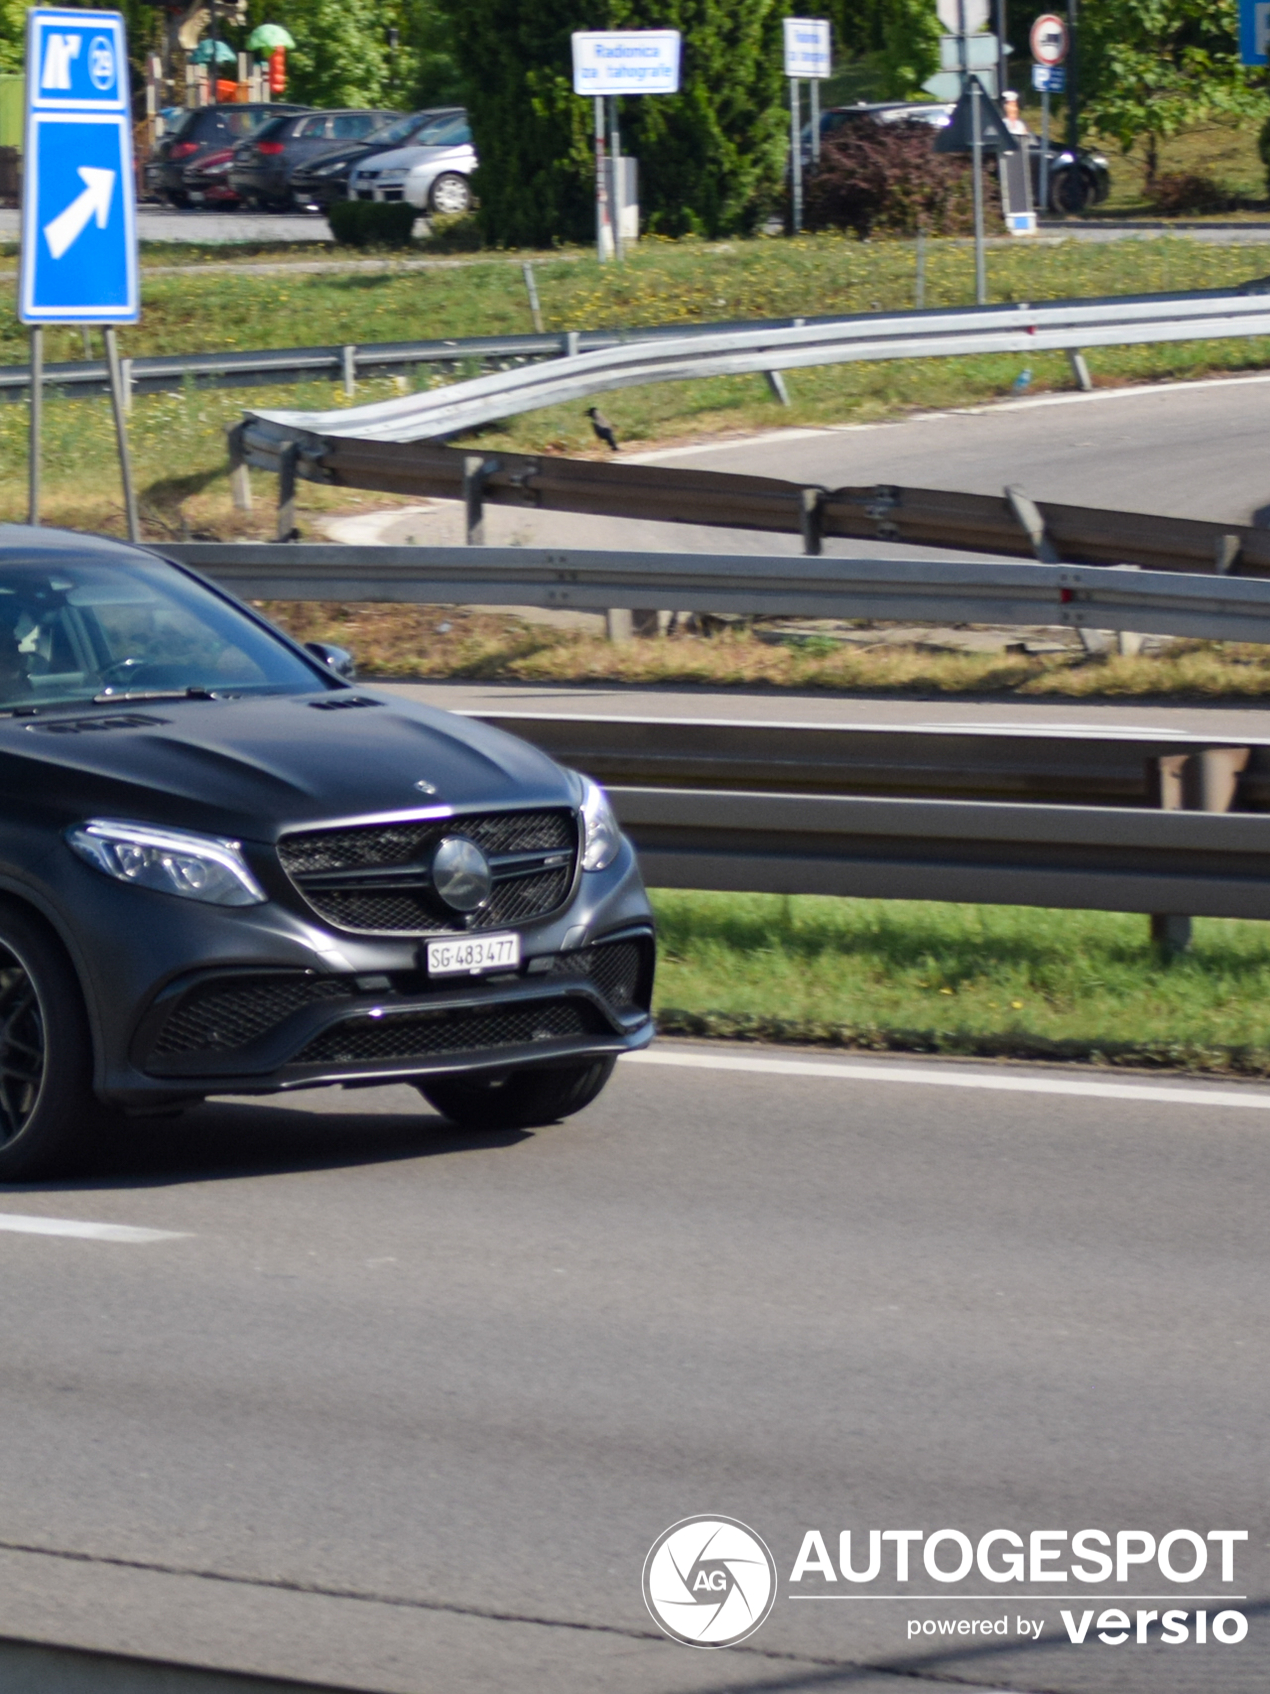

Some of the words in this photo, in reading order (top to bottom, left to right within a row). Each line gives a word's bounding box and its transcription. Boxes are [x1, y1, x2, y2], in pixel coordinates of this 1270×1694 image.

[594, 44, 660, 58] Radionica
[91, 49, 112, 77] 29
[581, 68, 598, 78] za
